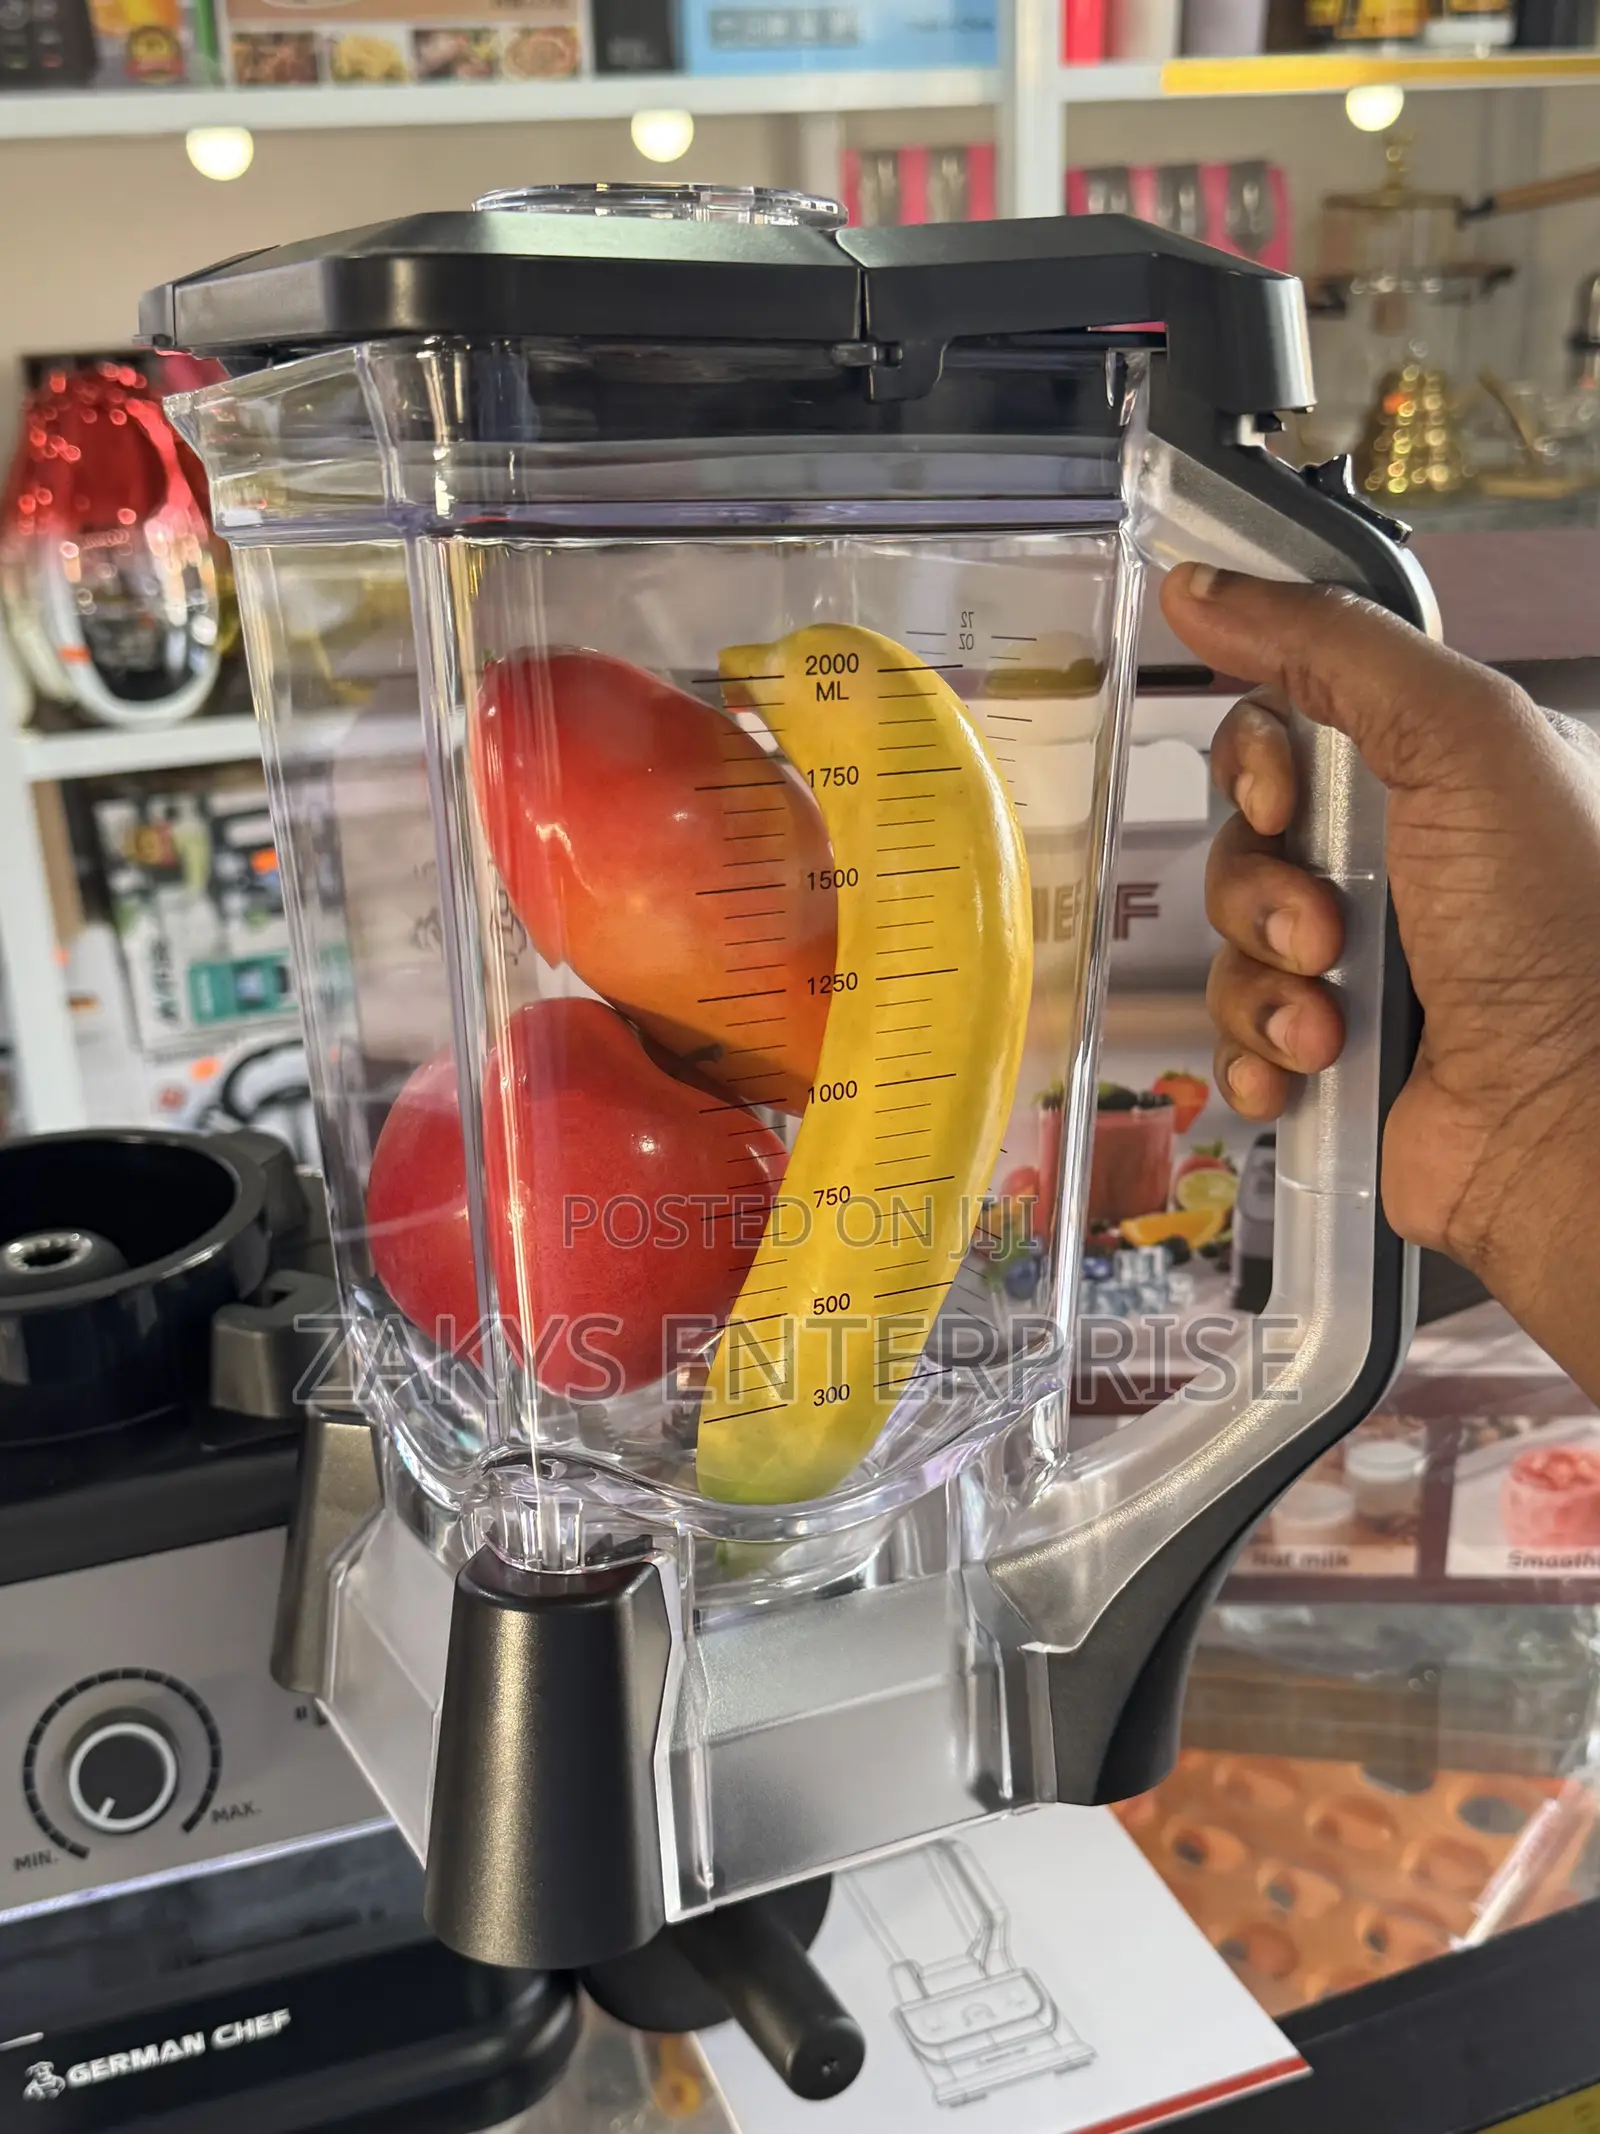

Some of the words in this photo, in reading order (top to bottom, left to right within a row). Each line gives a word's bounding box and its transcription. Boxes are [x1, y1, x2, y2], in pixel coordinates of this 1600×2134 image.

[805, 653, 859, 676] 2000
[815, 681, 850, 702] ML
[806, 766, 859, 789] 1750
[807, 868, 859, 891] 1500
[807, 972, 858, 996] 1250
[807, 1080, 858, 1104] 1000
[813, 1186, 851, 1208] 750
[813, 1293, 851, 1315] 500
[813, 1384, 850, 1407] 300
[210, 1801, 262, 1825] MAX.
[13, 1848, 60, 1872] MIN.
[66, 2031, 206, 2089] GERMAN
[210, 2007, 292, 2051] CHEF
